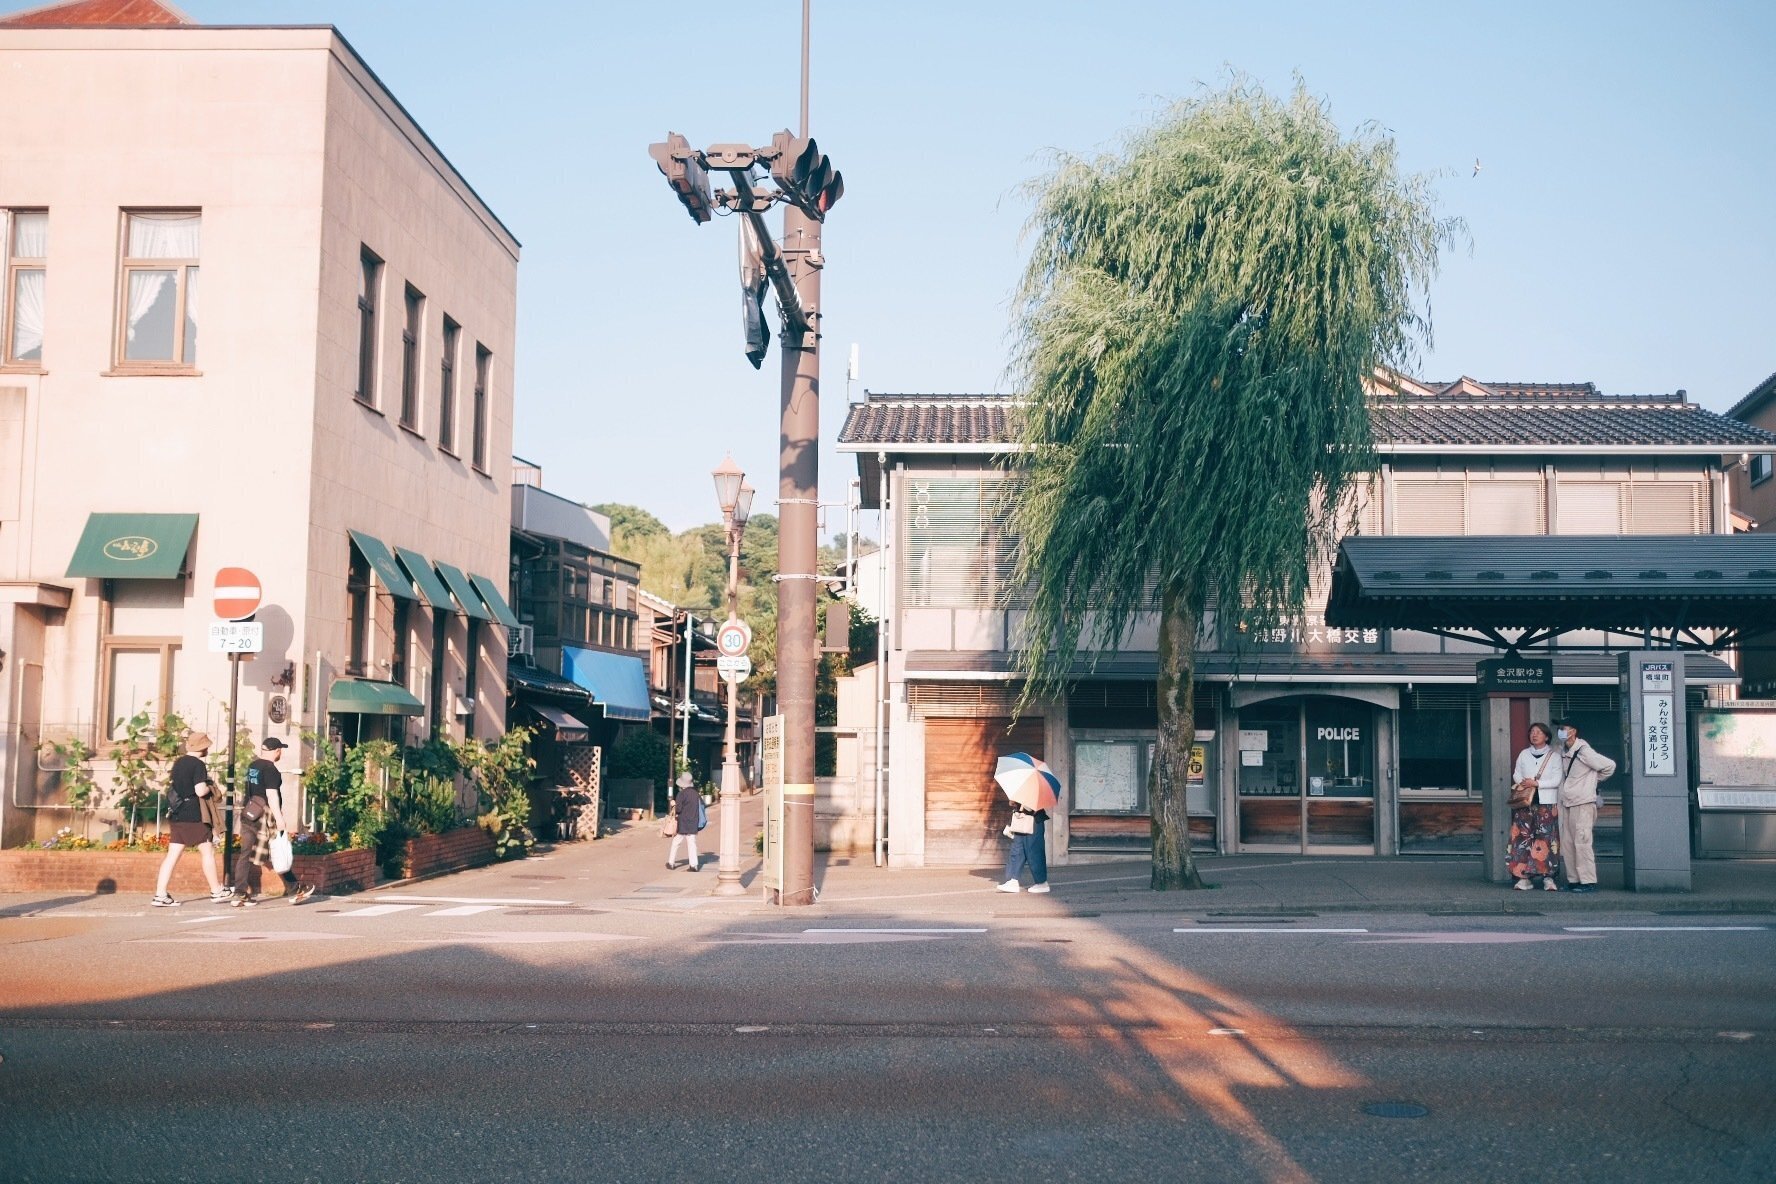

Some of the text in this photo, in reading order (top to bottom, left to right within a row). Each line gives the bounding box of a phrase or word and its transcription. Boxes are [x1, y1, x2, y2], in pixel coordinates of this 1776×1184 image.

[725, 634, 741, 648] 30
[1496, 667, 1544, 677] 金沢駅ゆき
[1317, 727, 1360, 740] POLICE
[1658, 699, 1669, 761] みんなで守ろう
[1648, 725, 1659, 769] 交通ルール
